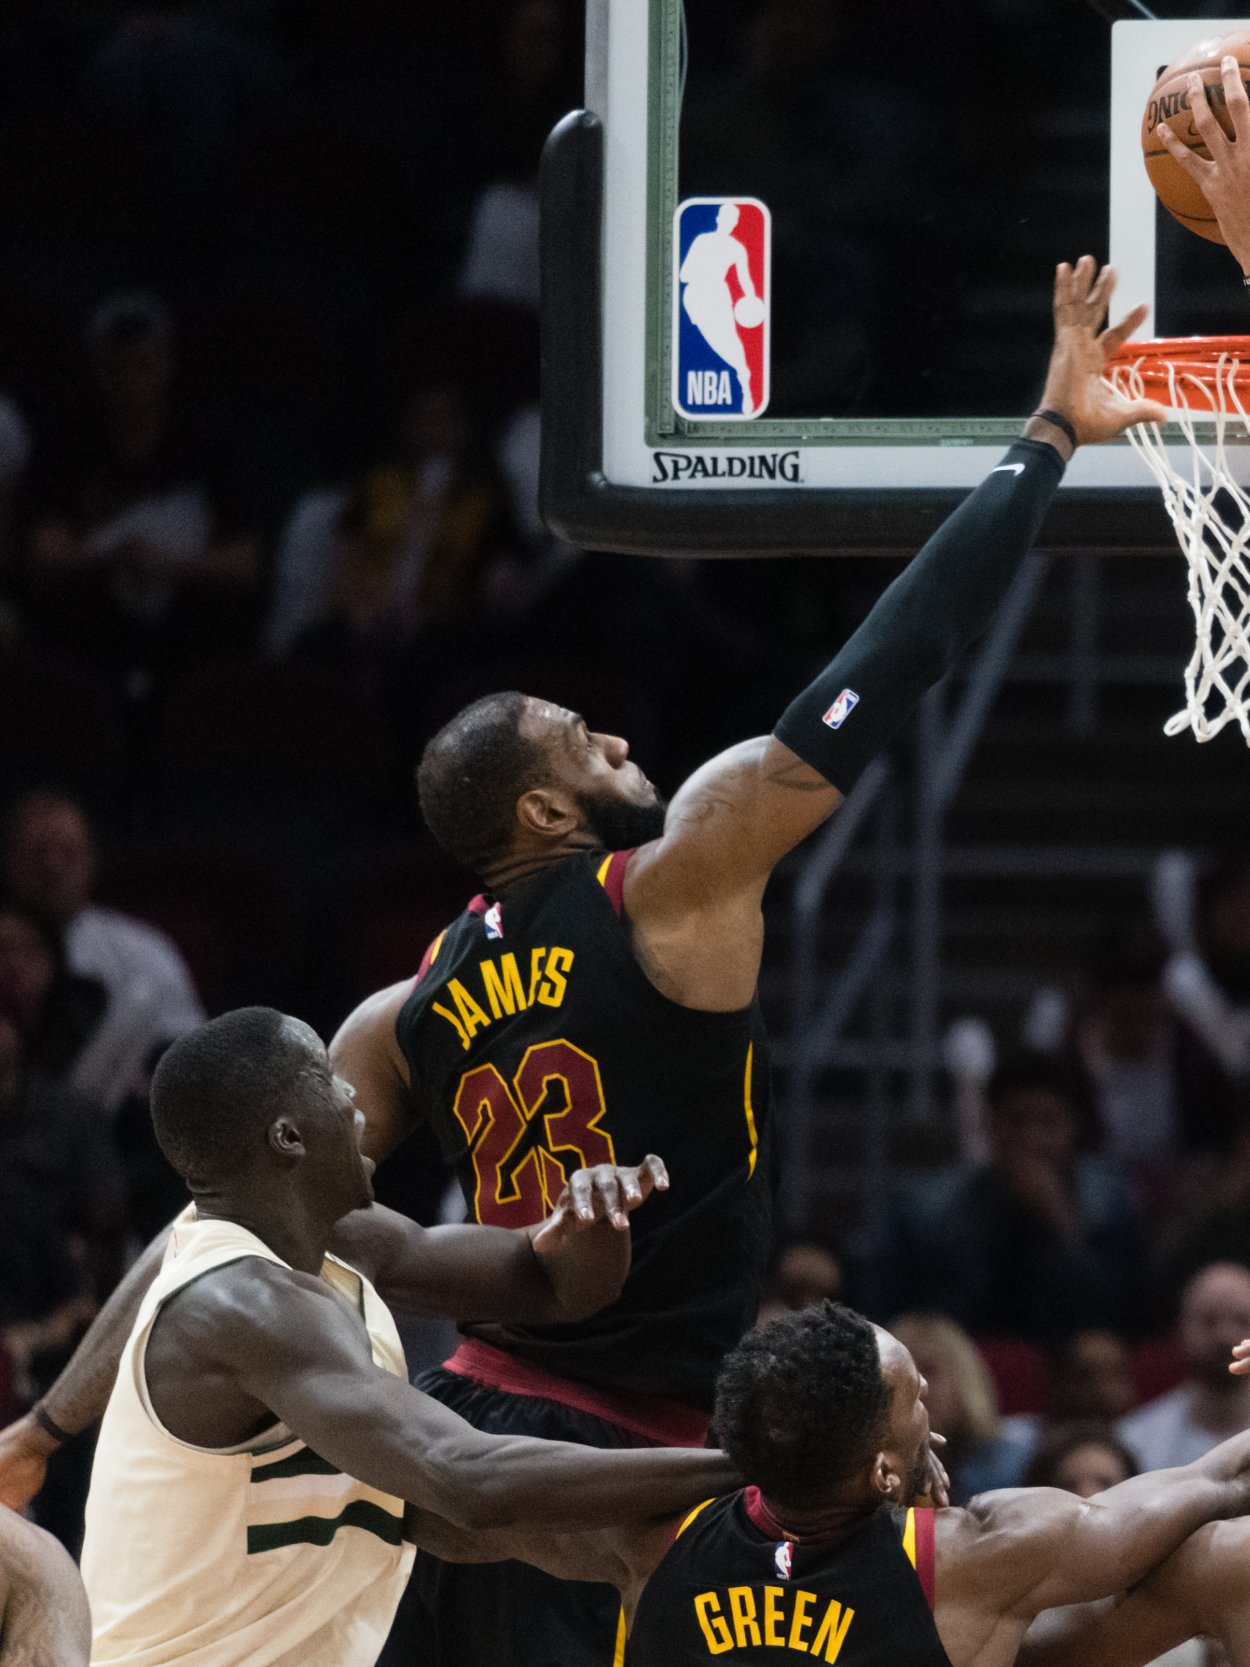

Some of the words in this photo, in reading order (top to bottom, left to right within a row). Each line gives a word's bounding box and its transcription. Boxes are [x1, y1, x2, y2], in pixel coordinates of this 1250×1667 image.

[687, 370, 732, 406] NBA
[652, 450, 800, 484] SPALDING
[432, 946, 575, 1051] JAMES
[453, 1038, 616, 1230] 23
[694, 1585, 855, 1665] GREEN
